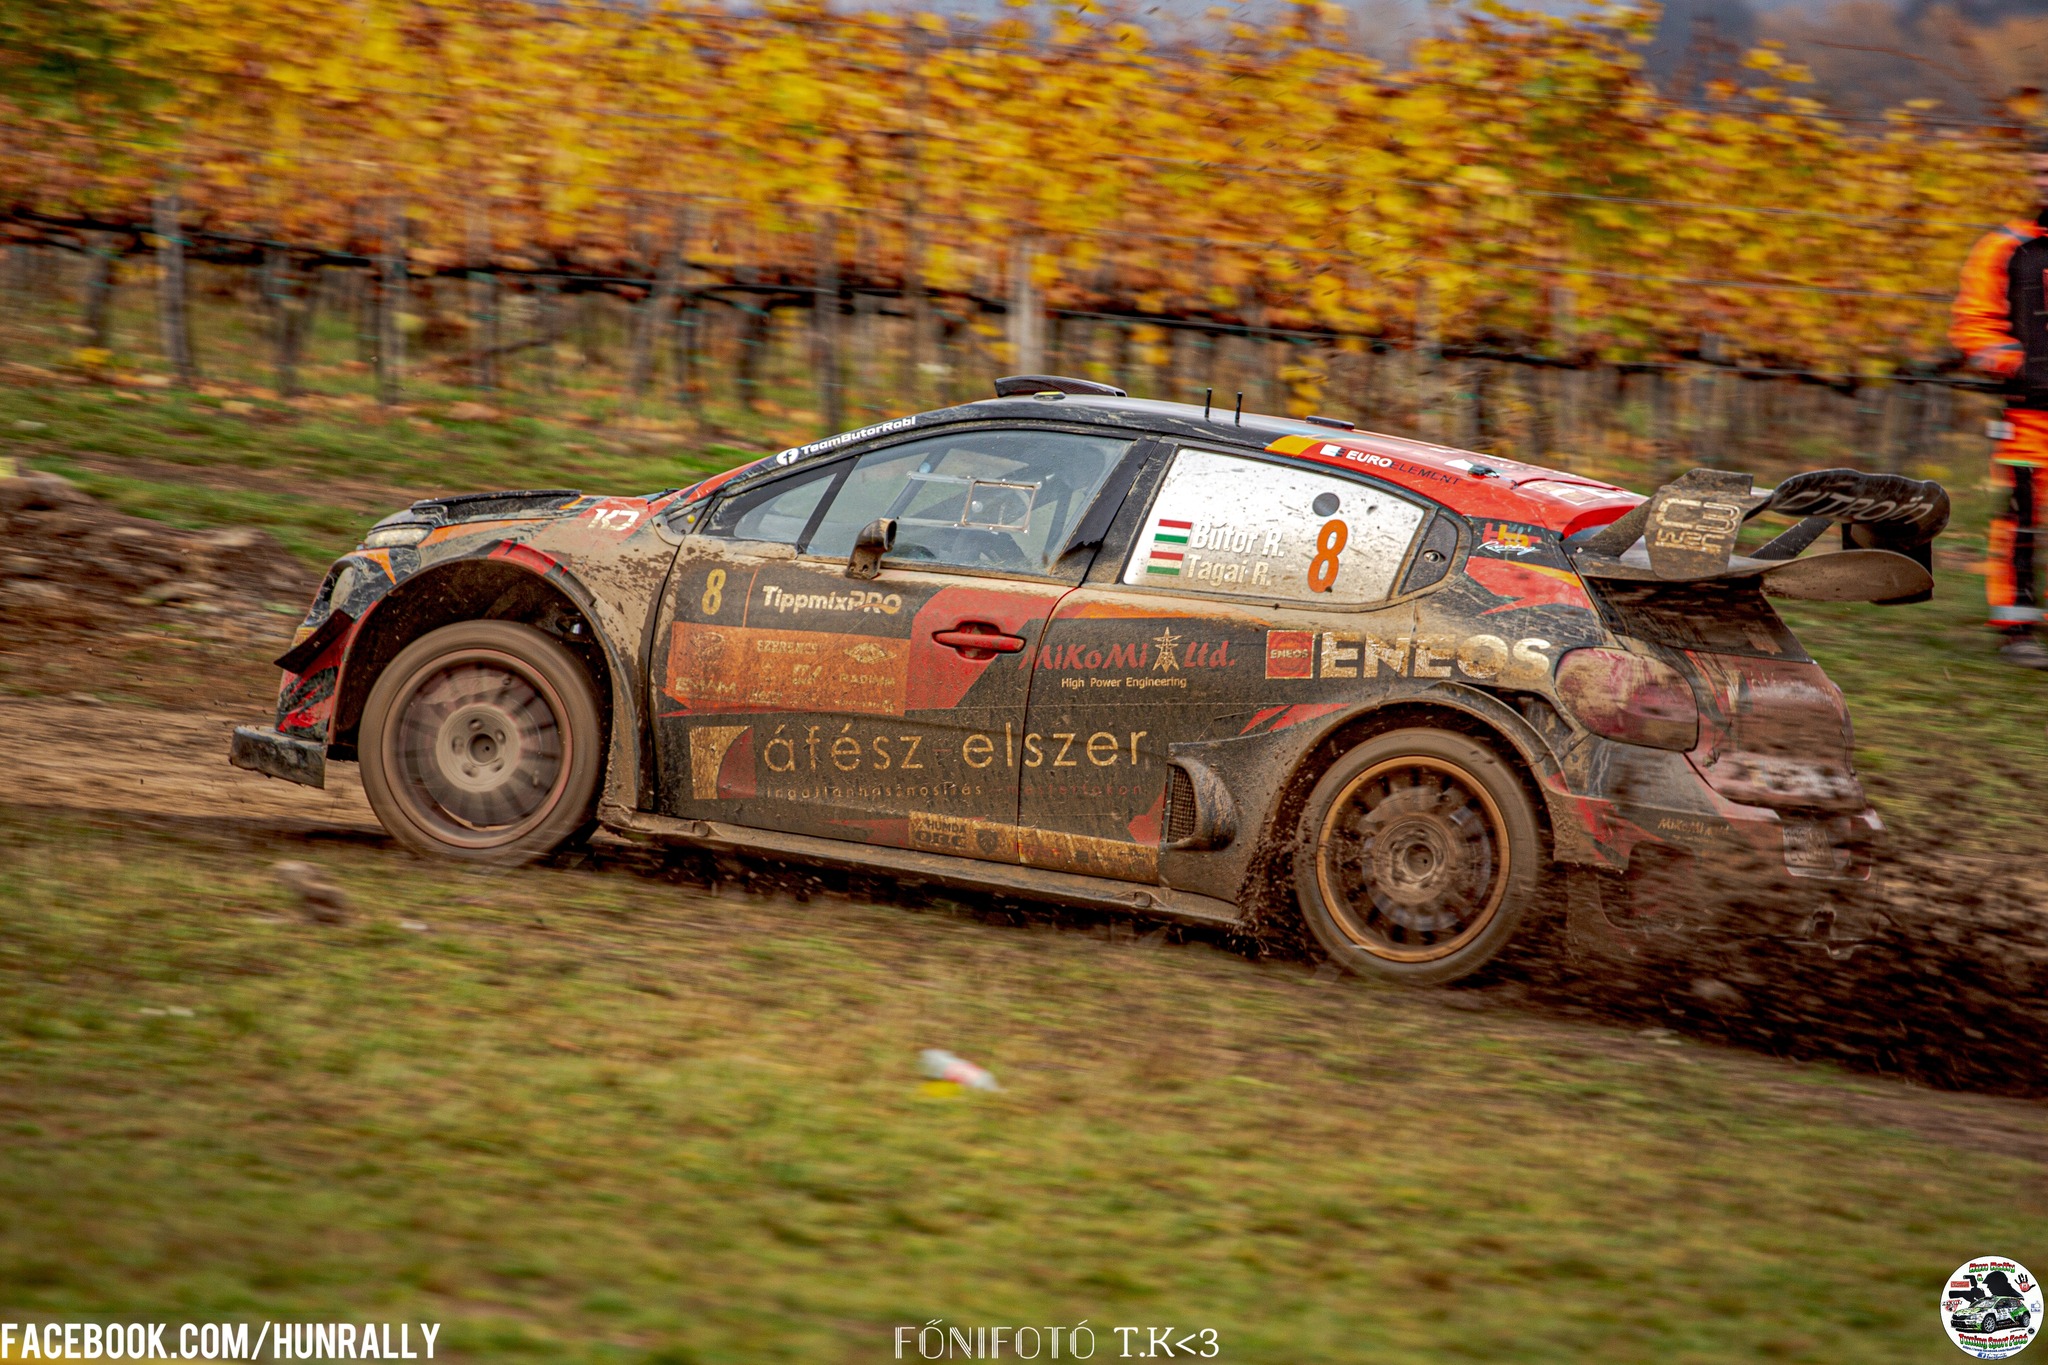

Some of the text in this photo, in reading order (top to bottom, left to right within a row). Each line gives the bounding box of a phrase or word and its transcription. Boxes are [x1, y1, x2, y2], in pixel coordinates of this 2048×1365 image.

[1346, 450, 1462, 485] EUROELEMENT
[1191, 521, 1285, 557] Bútor R.
[1308, 519, 1348, 593] 8
[1186, 553, 1271, 586] Tagai R.
[702, 568, 726, 615] 8
[763, 585, 901, 615] TippmixPRO
[1018, 640, 1236, 670] MiKoMi Ltd.
[1270, 649, 1309, 659] ENEOS
[1320, 631, 1551, 680] ENEOS
[1061, 677, 1187, 689] High Power Engineering
[764, 722, 1148, 772] áfész elszer
[927, 819, 967, 833] HUMDA
